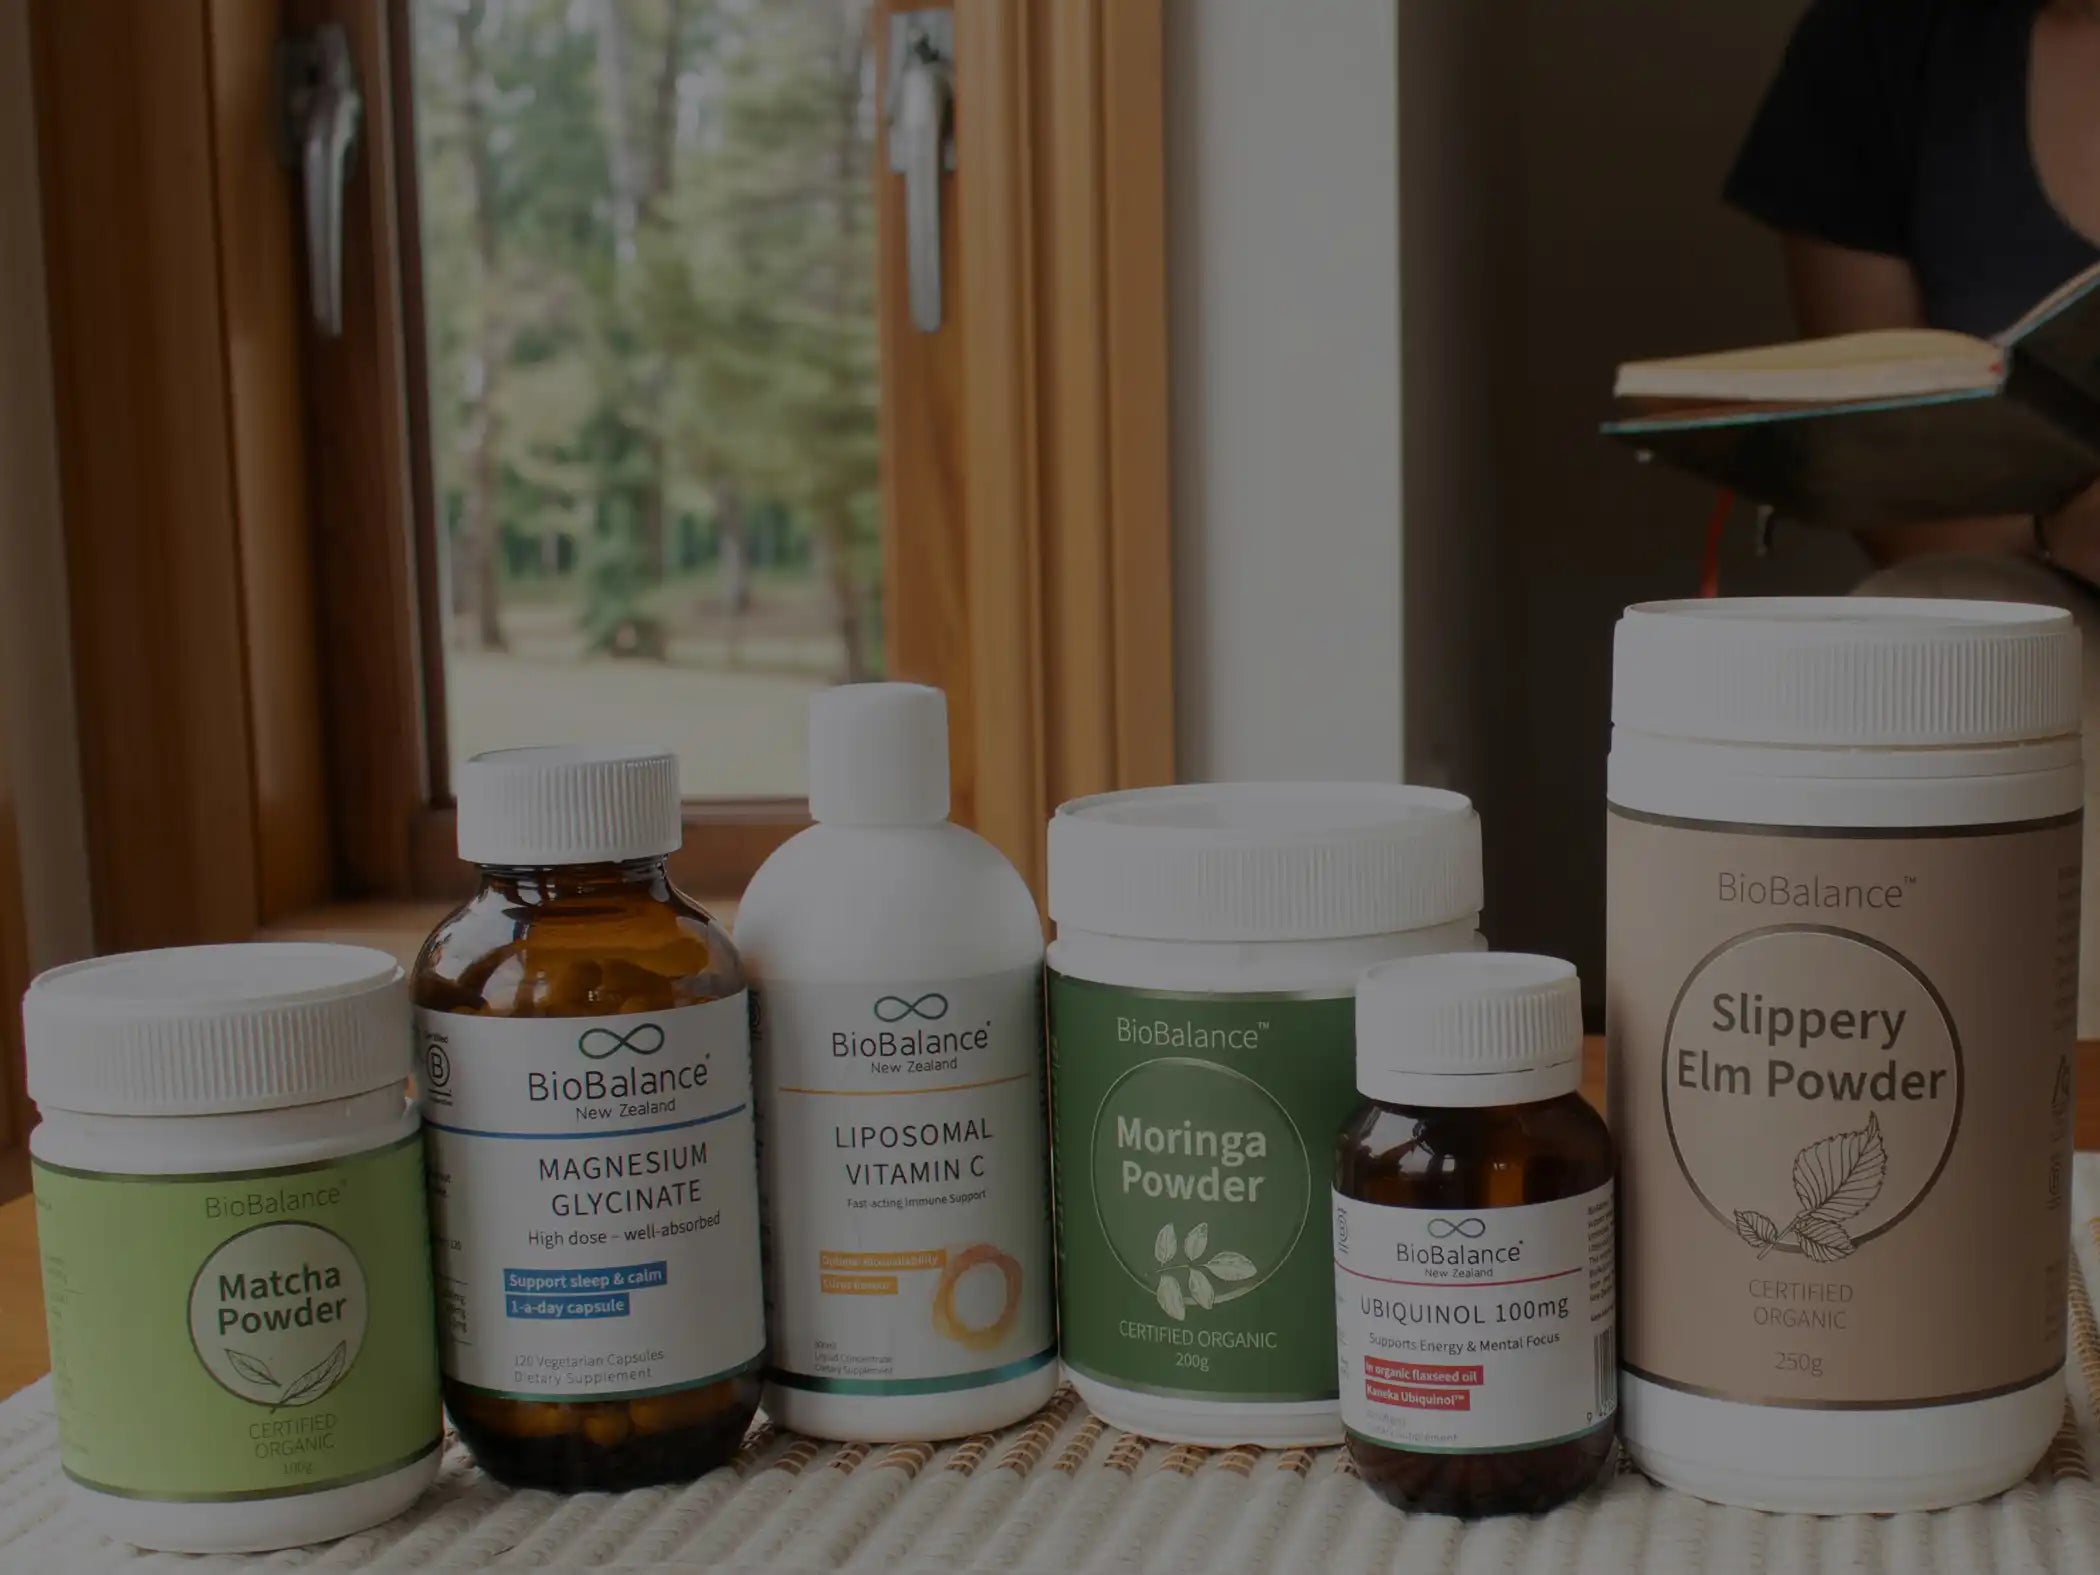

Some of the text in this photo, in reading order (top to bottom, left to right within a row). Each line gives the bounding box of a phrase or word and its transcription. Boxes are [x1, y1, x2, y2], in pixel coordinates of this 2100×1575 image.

[1711, 991, 1906, 1050] Slippery
[871, 1058, 958, 1075] New Zealand
[1677, 1049, 1946, 1102] Elm Powder
[576, 1098, 676, 1122] New Zealand
[835, 1118, 995, 1149] LIPOSOMAL
[1117, 1115, 1267, 1168] Moringa
[539, 1142, 707, 1181] MAGNESIUM
[846, 1155, 985, 1186] VITAMIN C
[1121, 1160, 1266, 1203] Powder
[552, 1179, 702, 1217] GLYCINATE
[848, 1189, 987, 1211] Fast-acting Immune Support
[528, 1231, 564, 1250] High
[568, 1230, 607, 1247] dose
[624, 1212, 721, 1242] well-absorbed
[219, 1263, 342, 1303] Matcha
[508, 1267, 662, 1292] Support sleep & calm
[1424, 1266, 1494, 1279] New Zealand
[1748, 1278, 1853, 1303] CERTIFIED
[217, 1296, 347, 1335] Powder
[511, 1298, 624, 1318] 1-a-day capsule
[1360, 1295, 1486, 1326] UBIQUINOL
[1496, 1296, 1569, 1323] 100mg
[1753, 1305, 1847, 1330] ORGANIC
[1119, 1319, 1278, 1350] CERTIFIED ORGANIC
[1369, 1332, 1560, 1356] Supports Energy & Mental Focus
[514, 1348, 666, 1371] 120 Vegetarian Capsules
[1175, 1352, 1210, 1373] 200g
[1774, 1351, 1823, 1377] 250g
[566, 1367, 652, 1389] Supplement
[1375, 1366, 1410, 1381] organic
[1412, 1368, 1460, 1383] flaxseed
[1462, 1371, 1477, 1383] oil
[1367, 1383, 1400, 1400] Kaneka
[249, 1412, 337, 1440] CERTIFIED
[255, 1432, 336, 1459] ORGANIC
